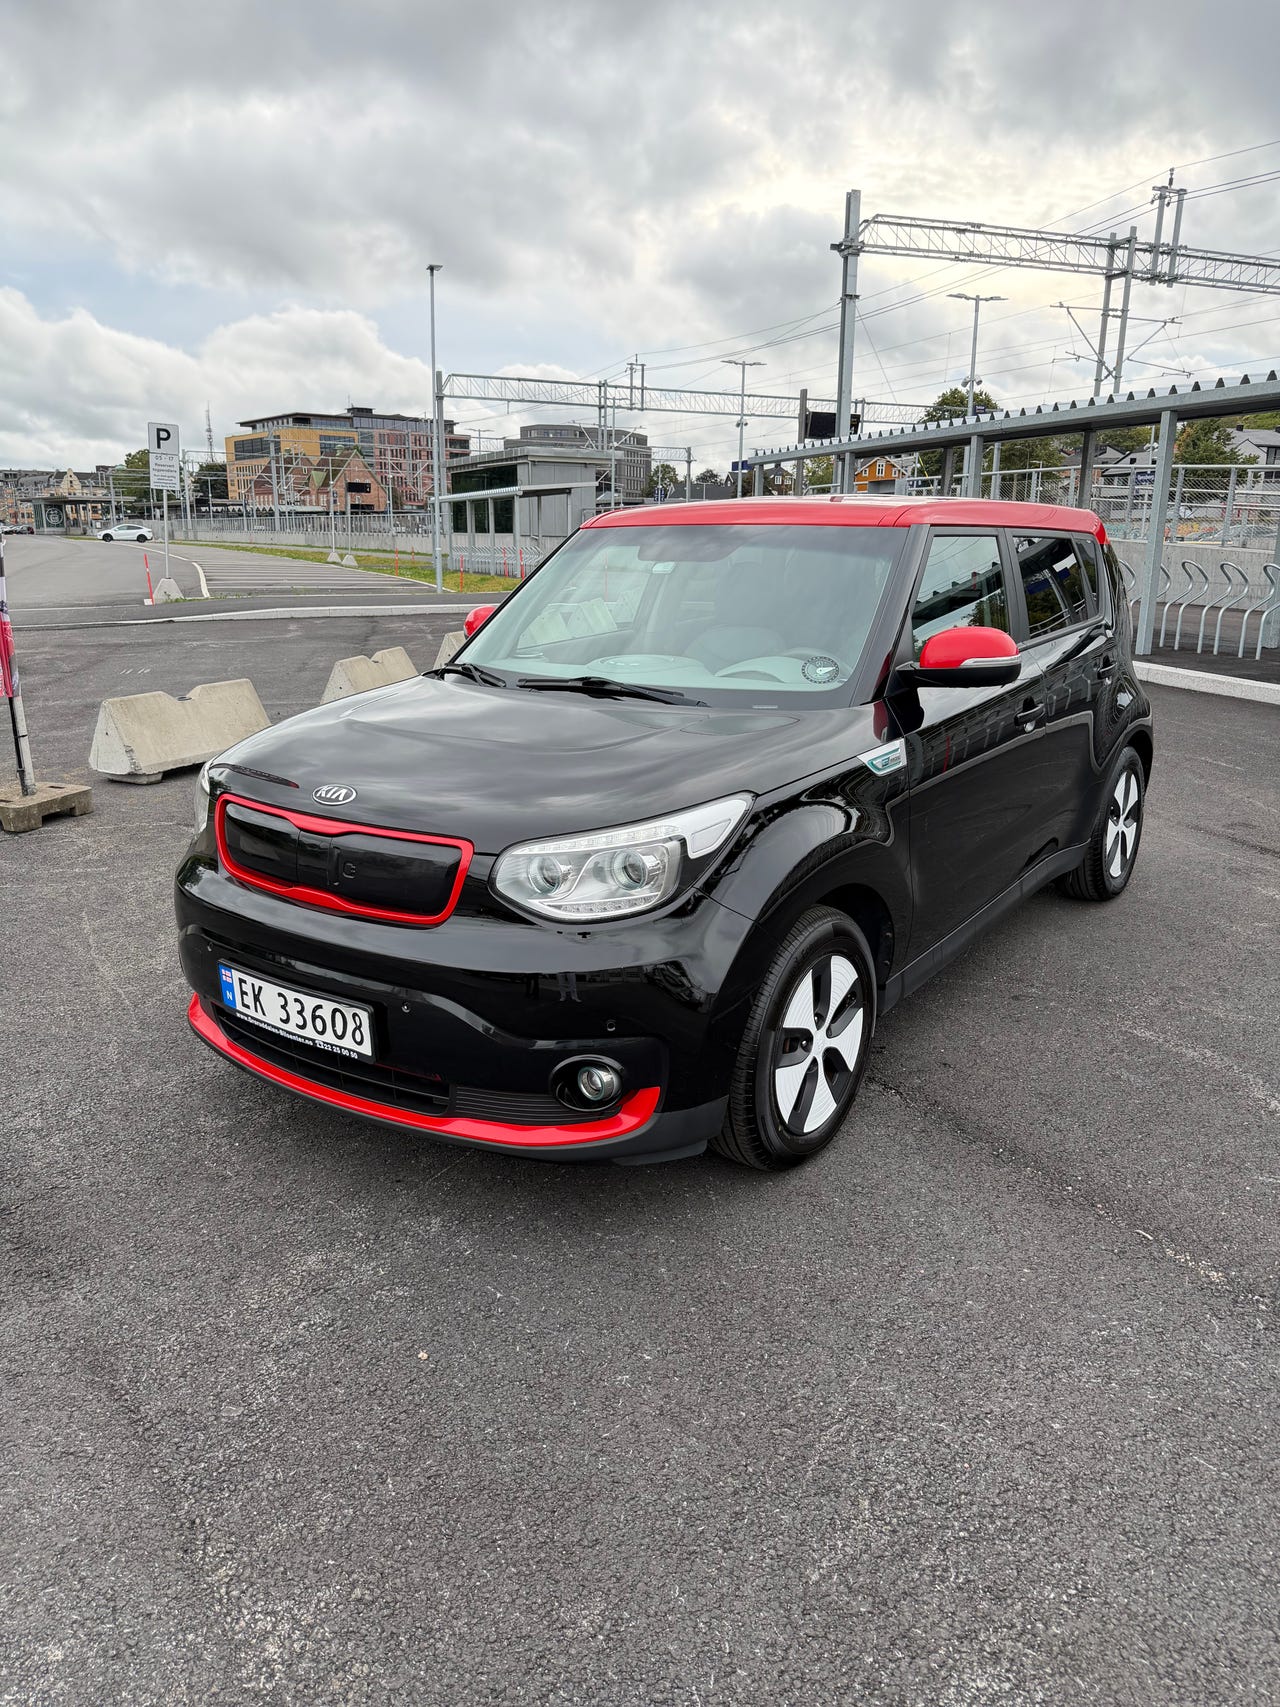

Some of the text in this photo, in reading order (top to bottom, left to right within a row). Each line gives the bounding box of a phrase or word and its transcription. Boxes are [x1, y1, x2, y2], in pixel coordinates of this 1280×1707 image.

[156, 428, 171, 449] P
[316, 786, 348, 801] KIA
[226, 991, 233, 1001] N
[238, 977, 364, 1046] EK 33608
